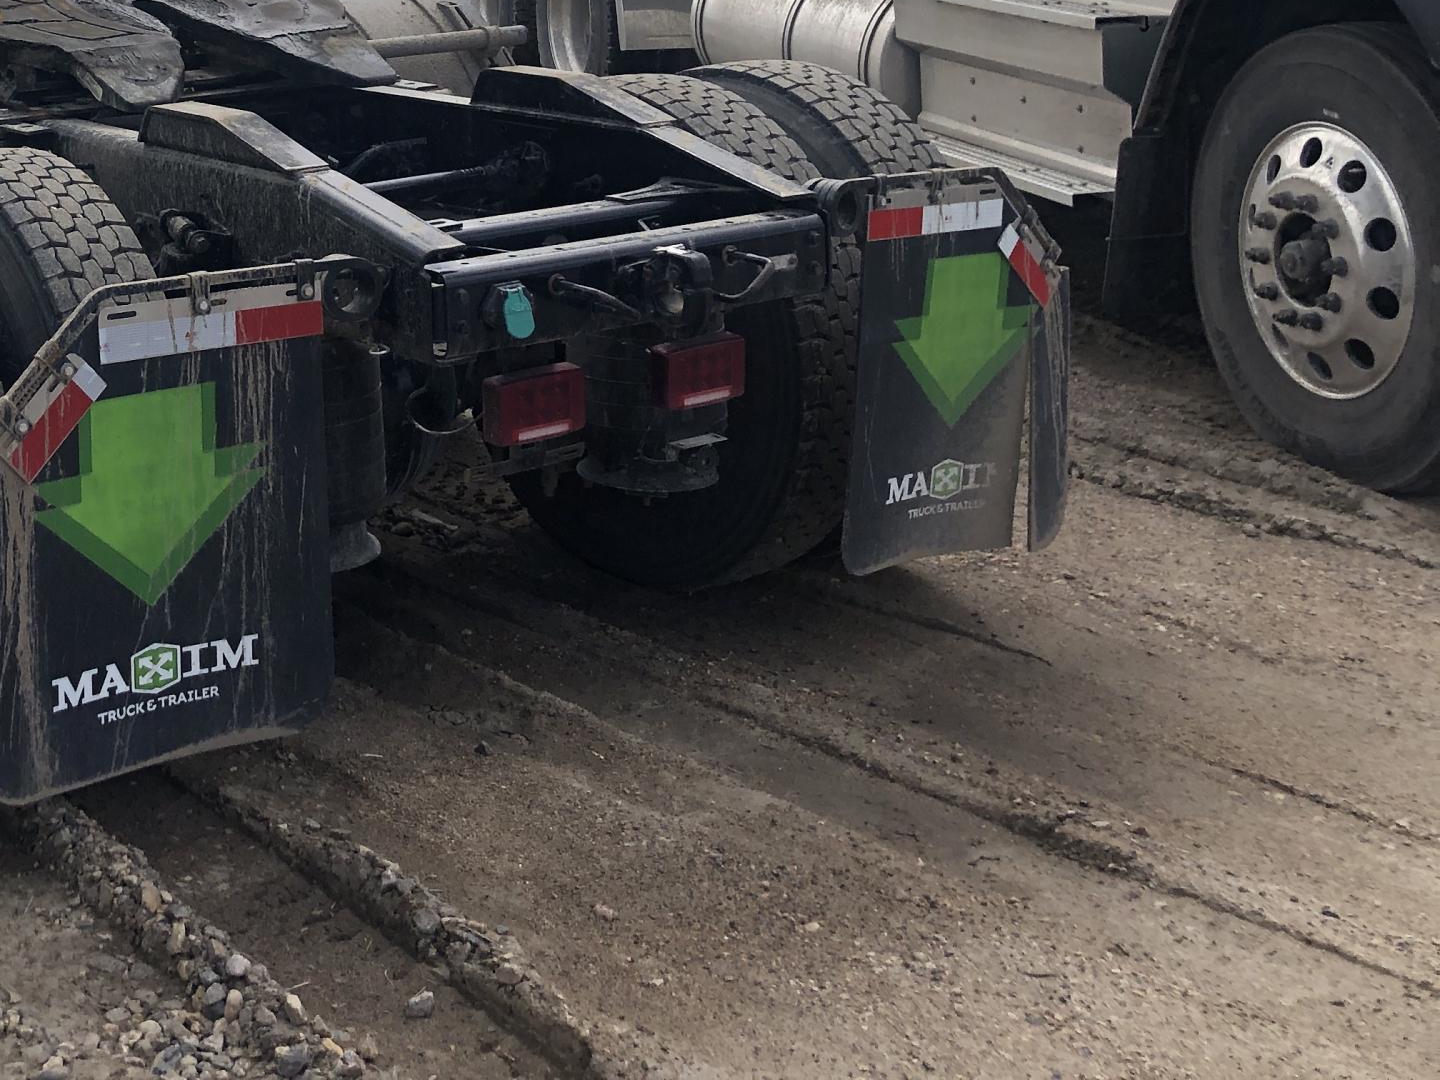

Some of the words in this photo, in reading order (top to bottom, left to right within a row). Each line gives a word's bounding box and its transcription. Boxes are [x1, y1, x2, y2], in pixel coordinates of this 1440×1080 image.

[908, 506, 936, 520] TRUCK
[52, 633, 259, 713] MAXIM
[98, 700, 145, 725] TRUCK
[147, 701, 157, 711] &
[158, 686, 220, 708] TRAILER
